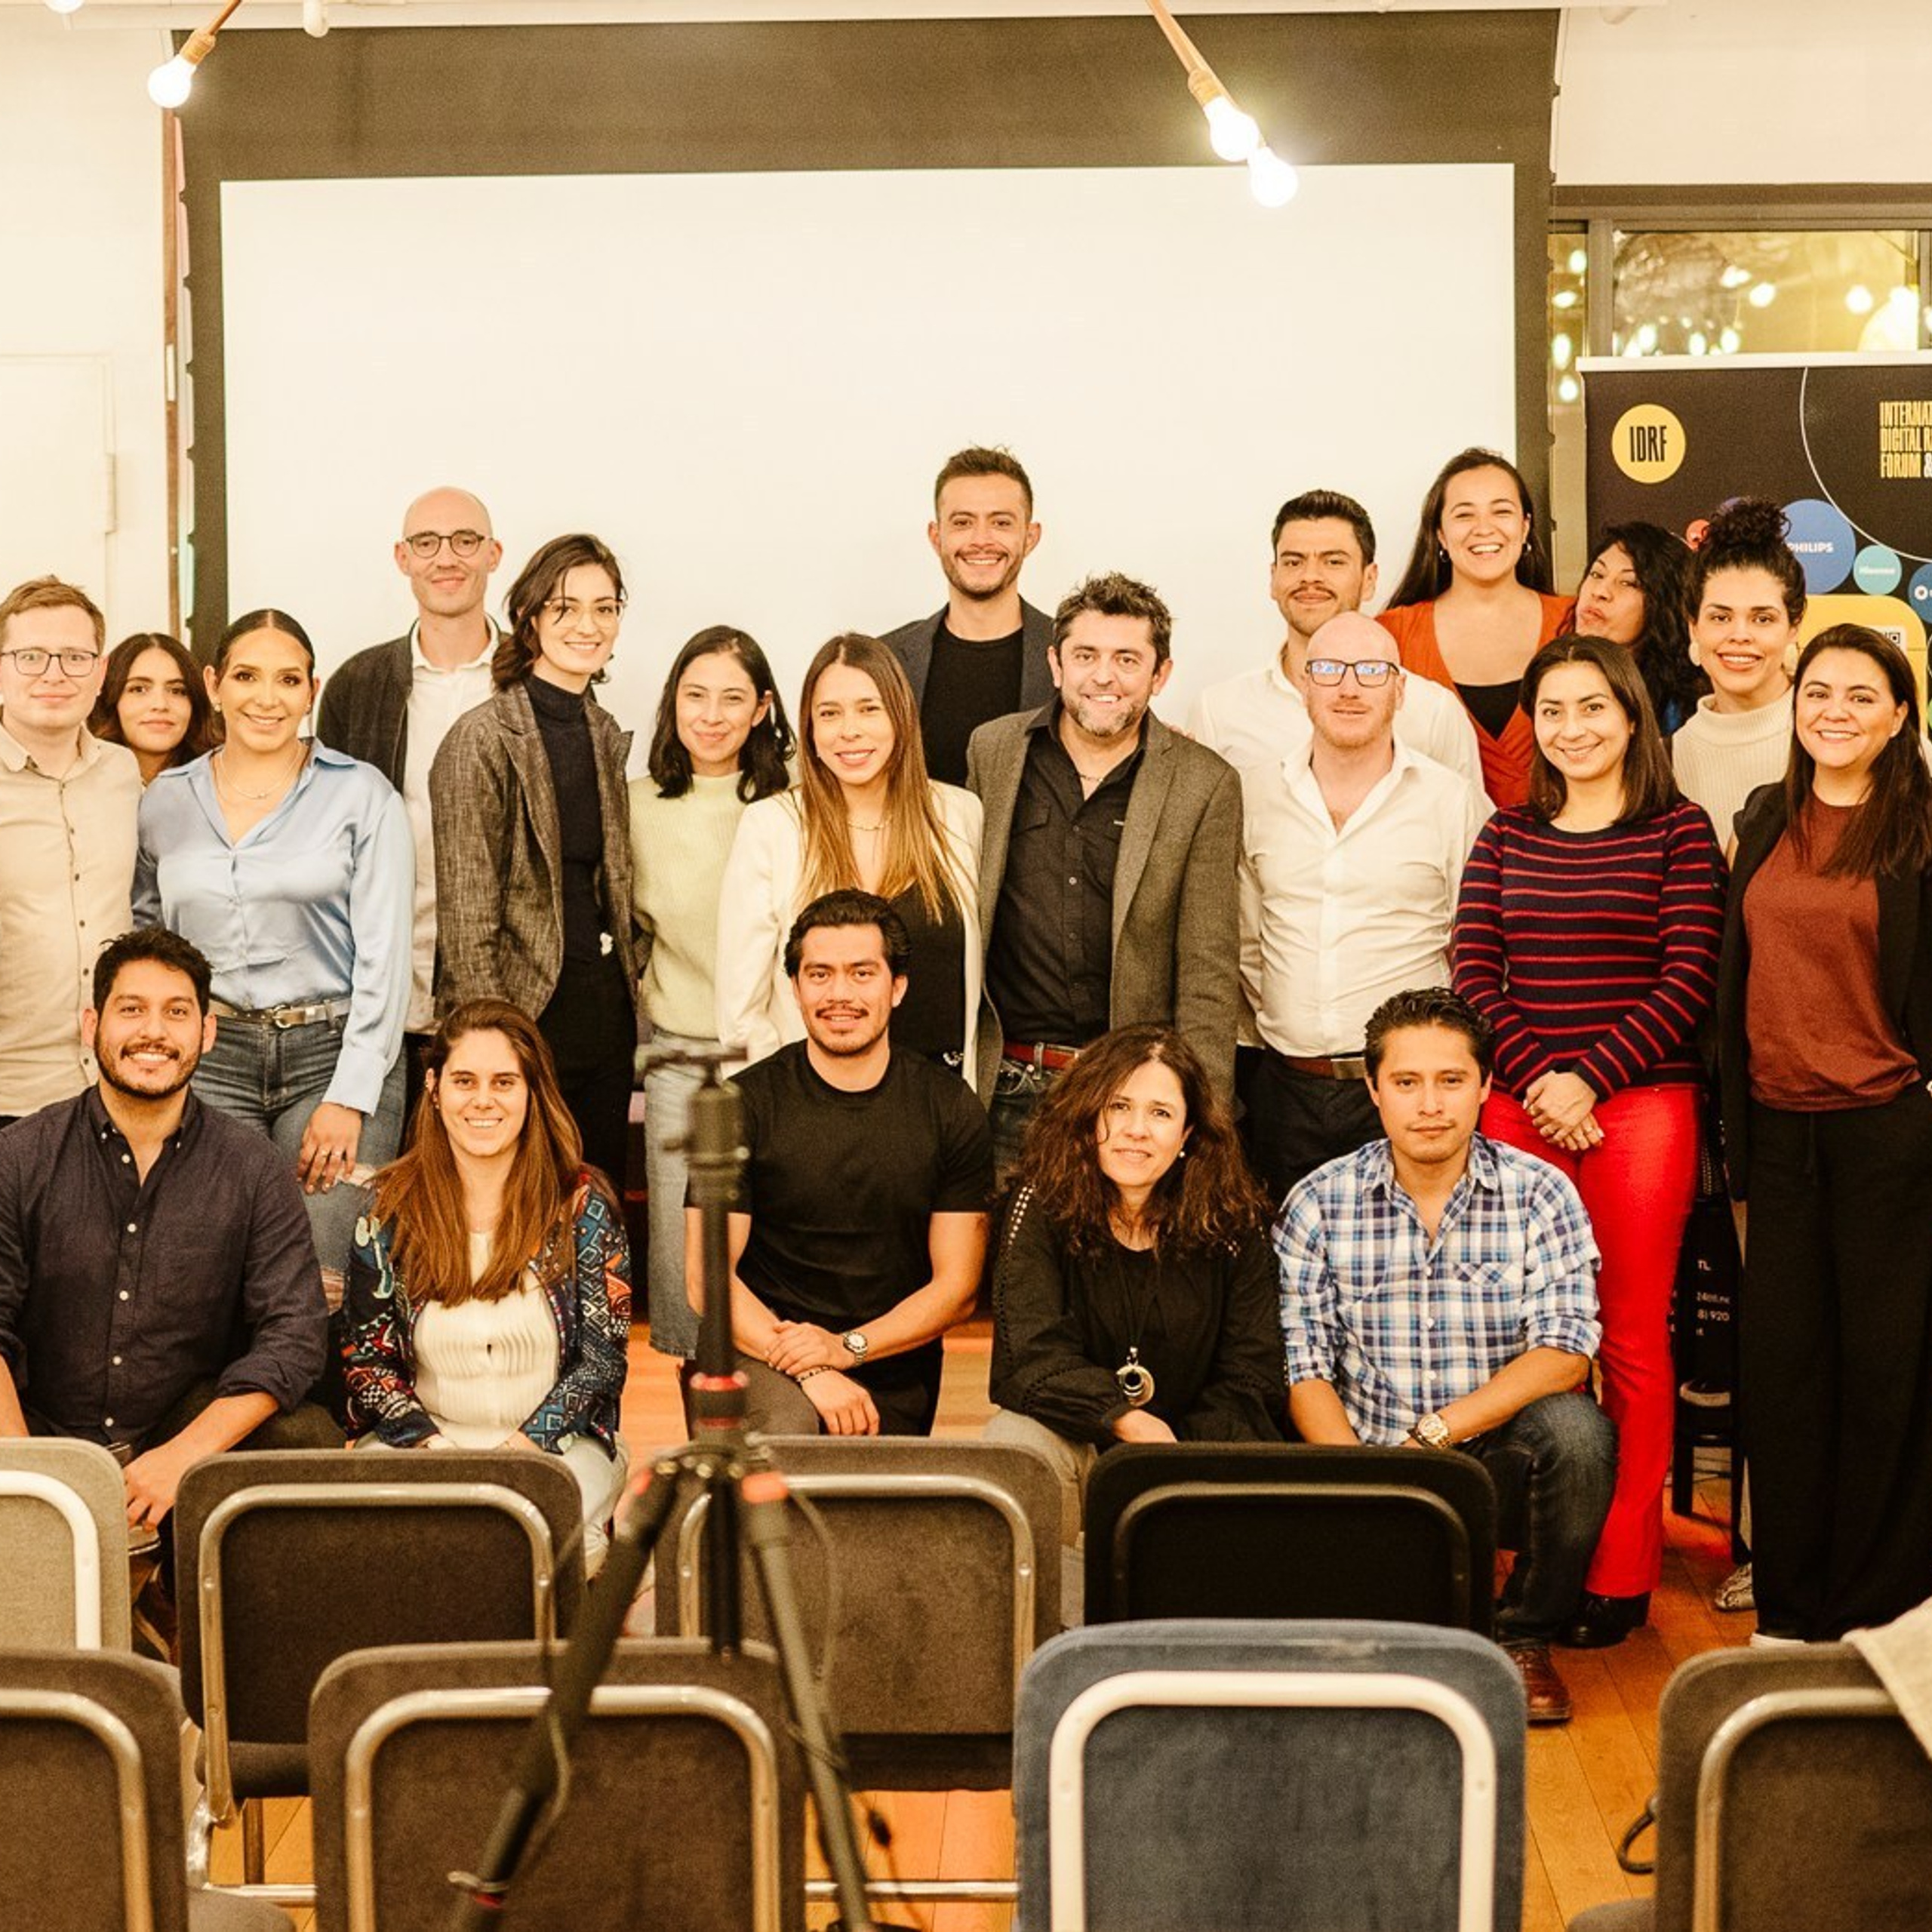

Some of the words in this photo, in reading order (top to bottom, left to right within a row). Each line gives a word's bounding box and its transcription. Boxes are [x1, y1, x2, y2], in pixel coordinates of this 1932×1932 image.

[1630, 426, 1667, 463] IDRF
[1879, 426, 1922, 452] DIGITAL
[1880, 452, 1921, 478] FORUM
[1786, 542, 1834, 553] PHILIPS
